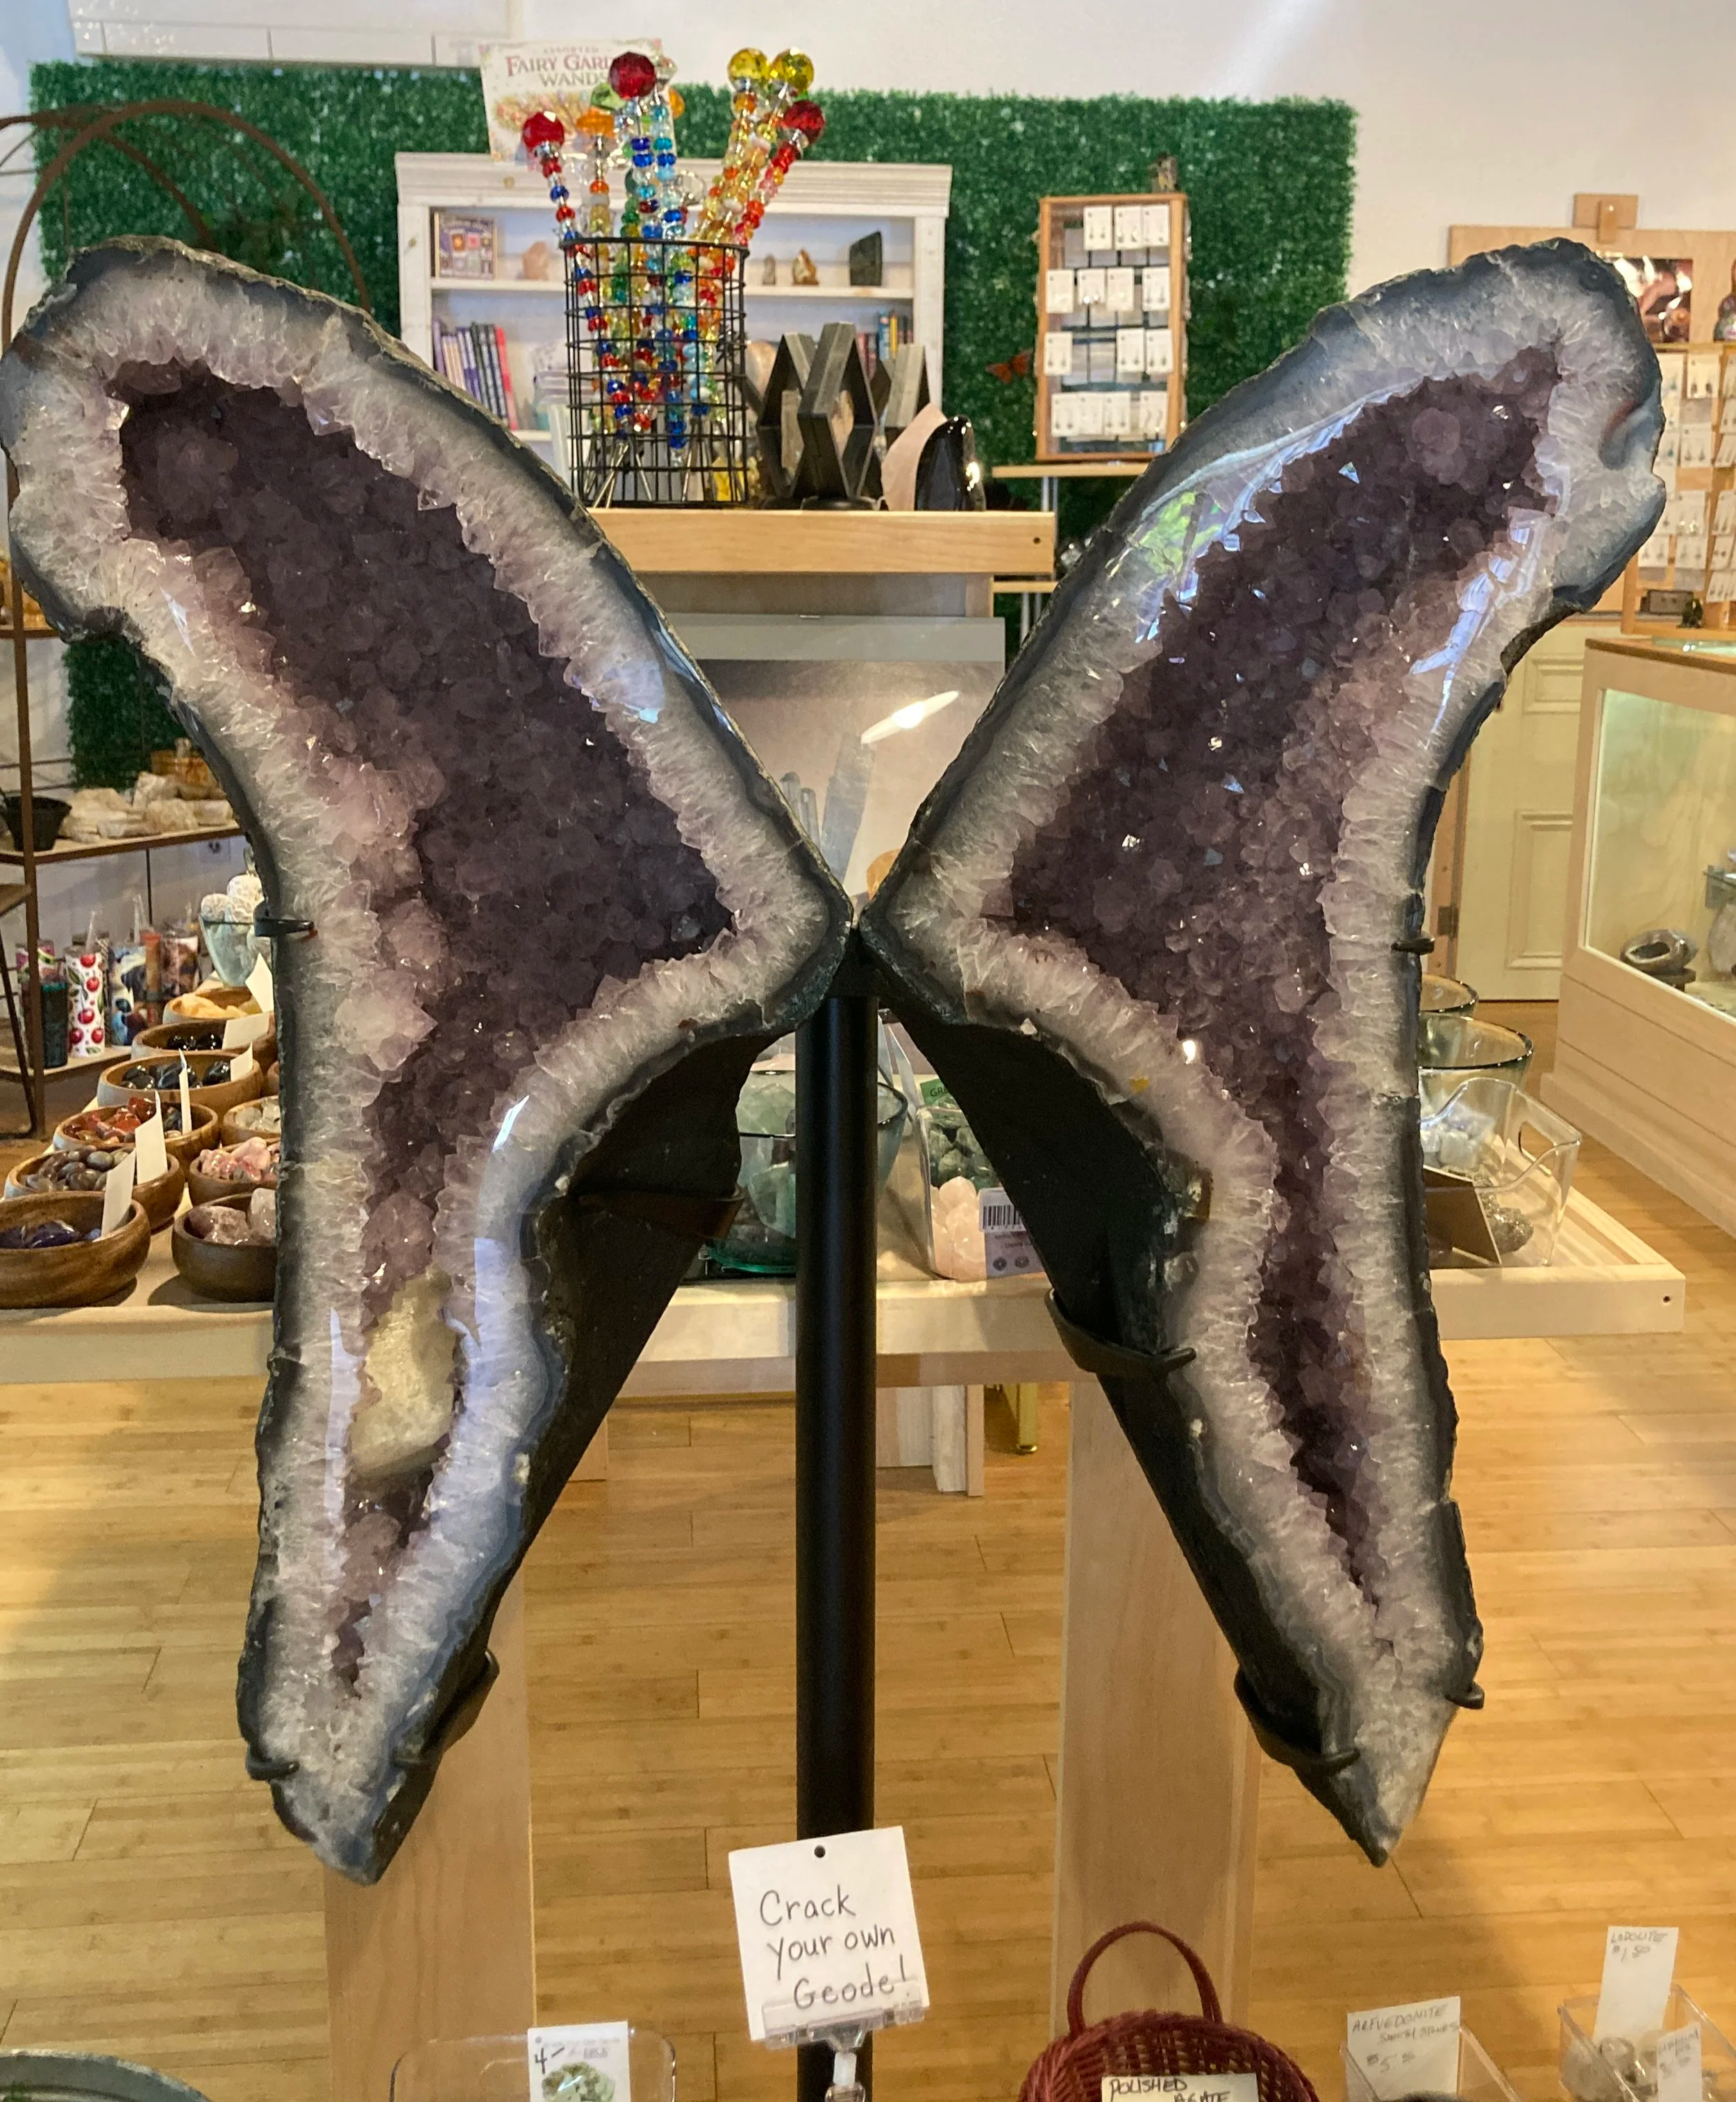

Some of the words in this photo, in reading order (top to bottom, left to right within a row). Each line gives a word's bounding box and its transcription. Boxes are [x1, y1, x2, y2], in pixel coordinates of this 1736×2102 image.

[506, 56, 556, 76] FAIRY
[760, 1884, 856, 1926] Crack
[766, 1936, 833, 1980] your
[844, 1924, 894, 1950] own
[793, 1953, 910, 2010] Geode!
[1109, 2078, 1187, 2102] POLISHED
